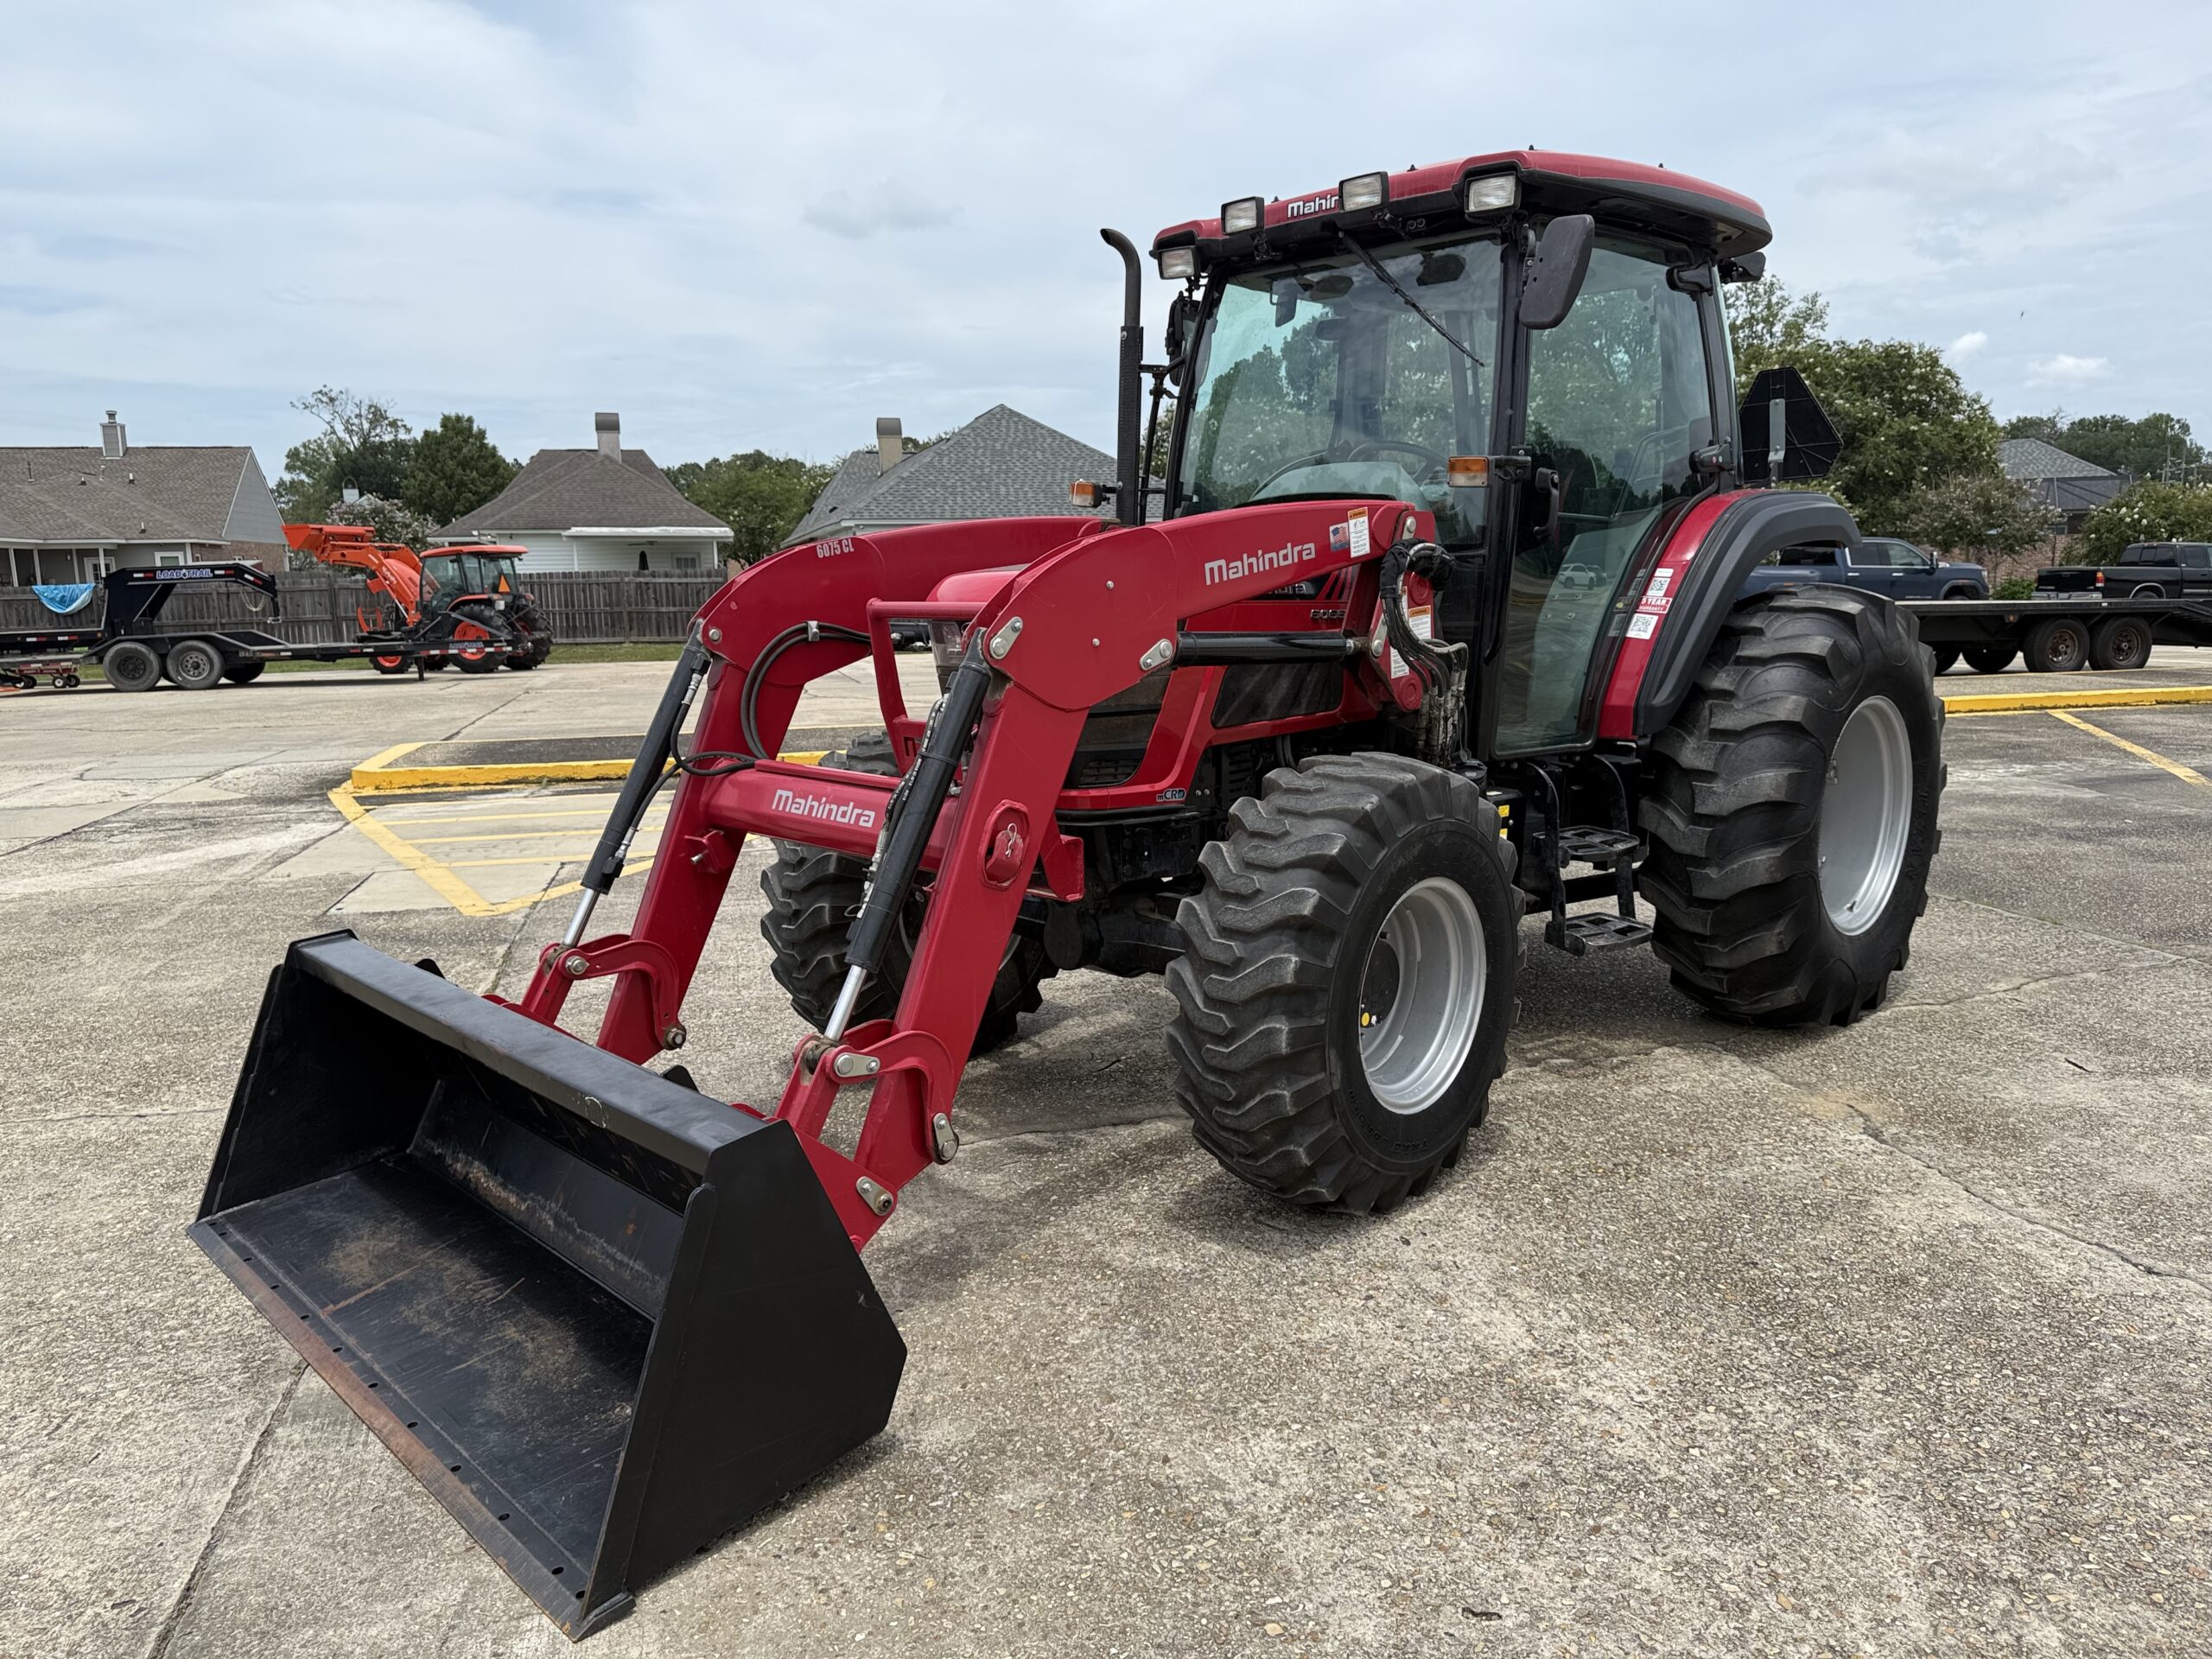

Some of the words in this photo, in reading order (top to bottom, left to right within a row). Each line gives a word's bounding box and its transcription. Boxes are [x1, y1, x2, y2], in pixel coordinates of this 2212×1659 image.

[816, 541, 842, 558] 6075
[842, 538, 855, 553] CL
[156, 569, 181, 580] LOAD
[186, 568, 213, 578] TRAIL
[1205, 542, 1316, 586] Mahindra
[772, 789, 875, 828] Mahindra
